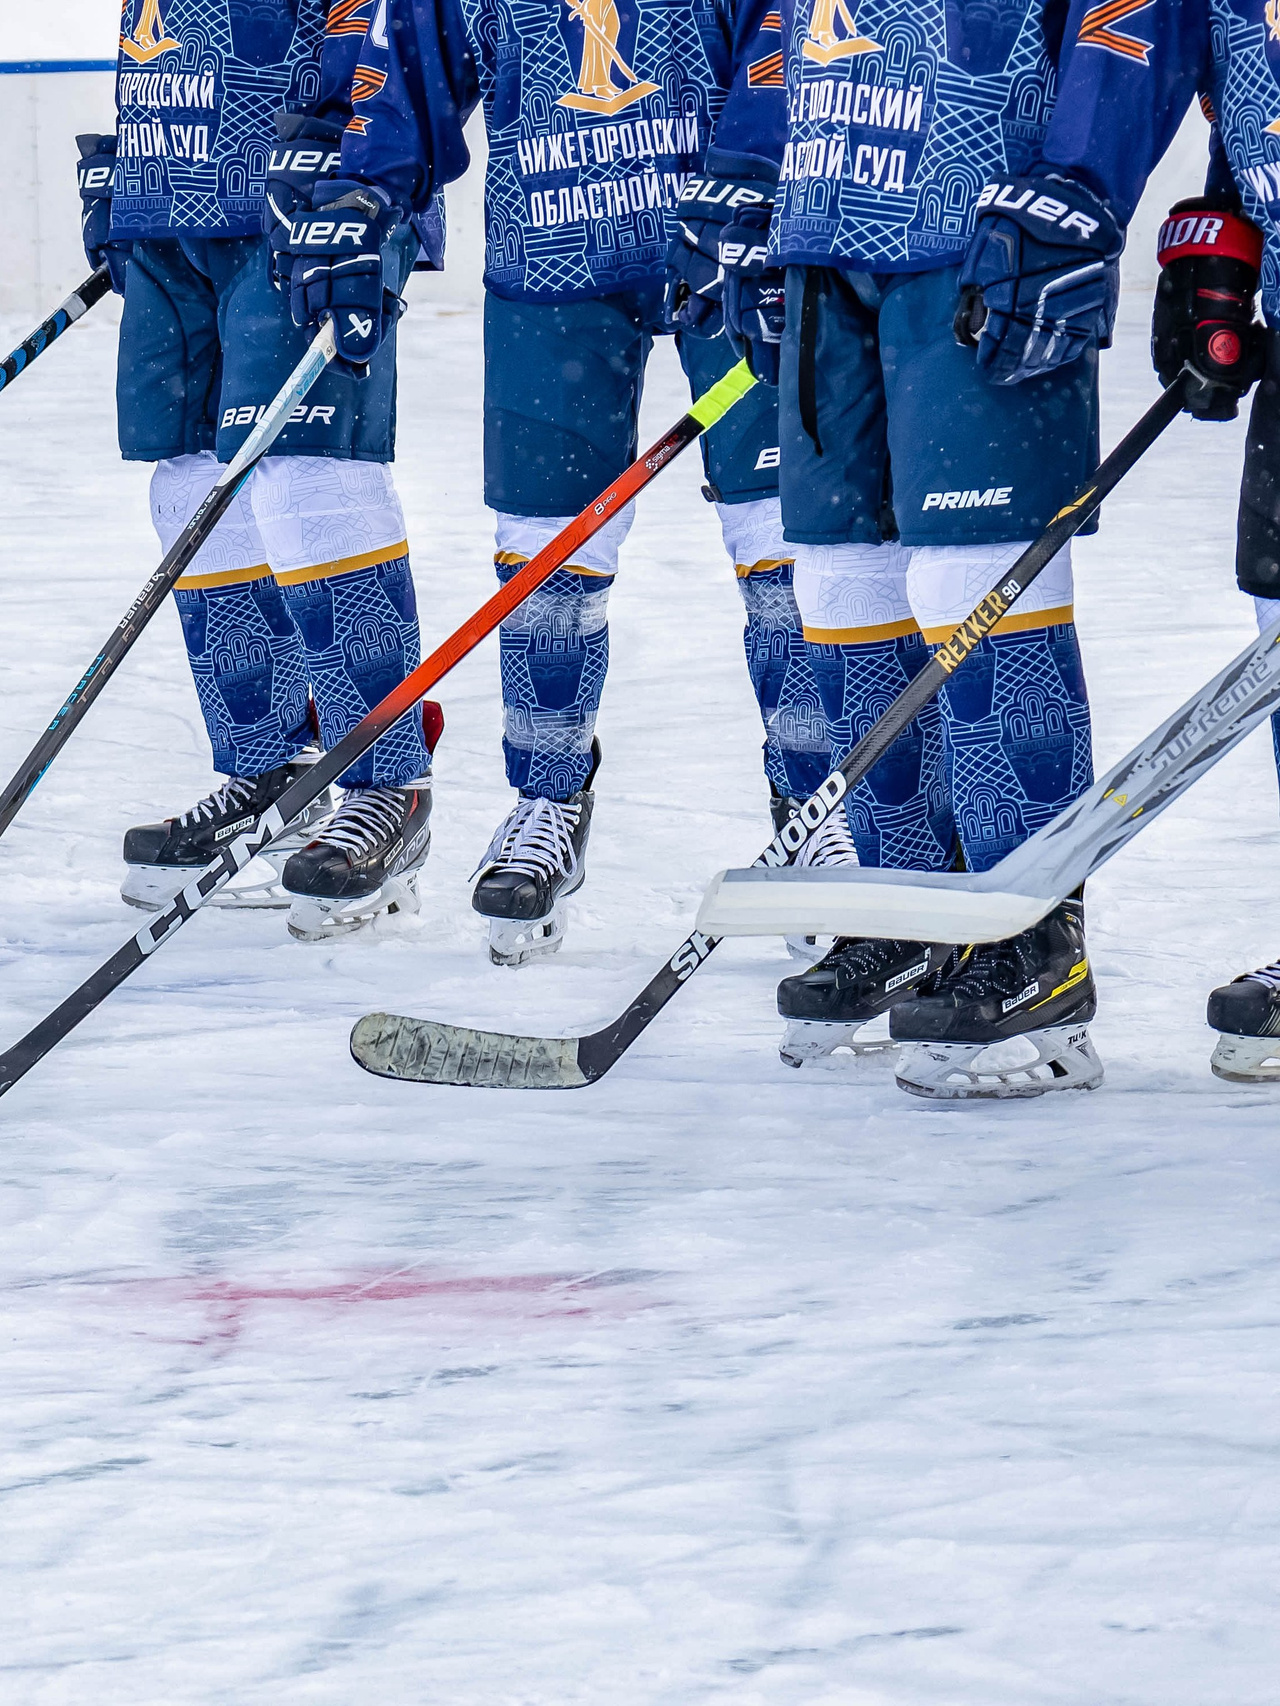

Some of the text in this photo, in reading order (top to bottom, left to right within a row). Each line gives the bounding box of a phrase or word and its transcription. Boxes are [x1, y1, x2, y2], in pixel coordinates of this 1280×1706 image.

[119, 70, 215, 110] ОРОДСКИЙ
[169, 124, 209, 163] СУД
[517, 110, 700, 175] НИЖЕГОРОДСКИЙ
[853, 144, 907, 194] СУД
[530, 167, 661, 227] ОБЛАСТНОЙ
[922, 486, 1014, 511] PRIME
[119, 580, 156, 629] BAUER
[1001, 579, 1022, 601] 90
[934, 590, 1009, 674] REKKER
[48, 653, 106, 731] TRACER
[1150, 662, 1273, 775] SUPREME
[217, 817, 253, 839] BAUER
[136, 802, 285, 955] CCM
[887, 963, 926, 989] BAUER
[1004, 985, 1038, 1010] BAUER
